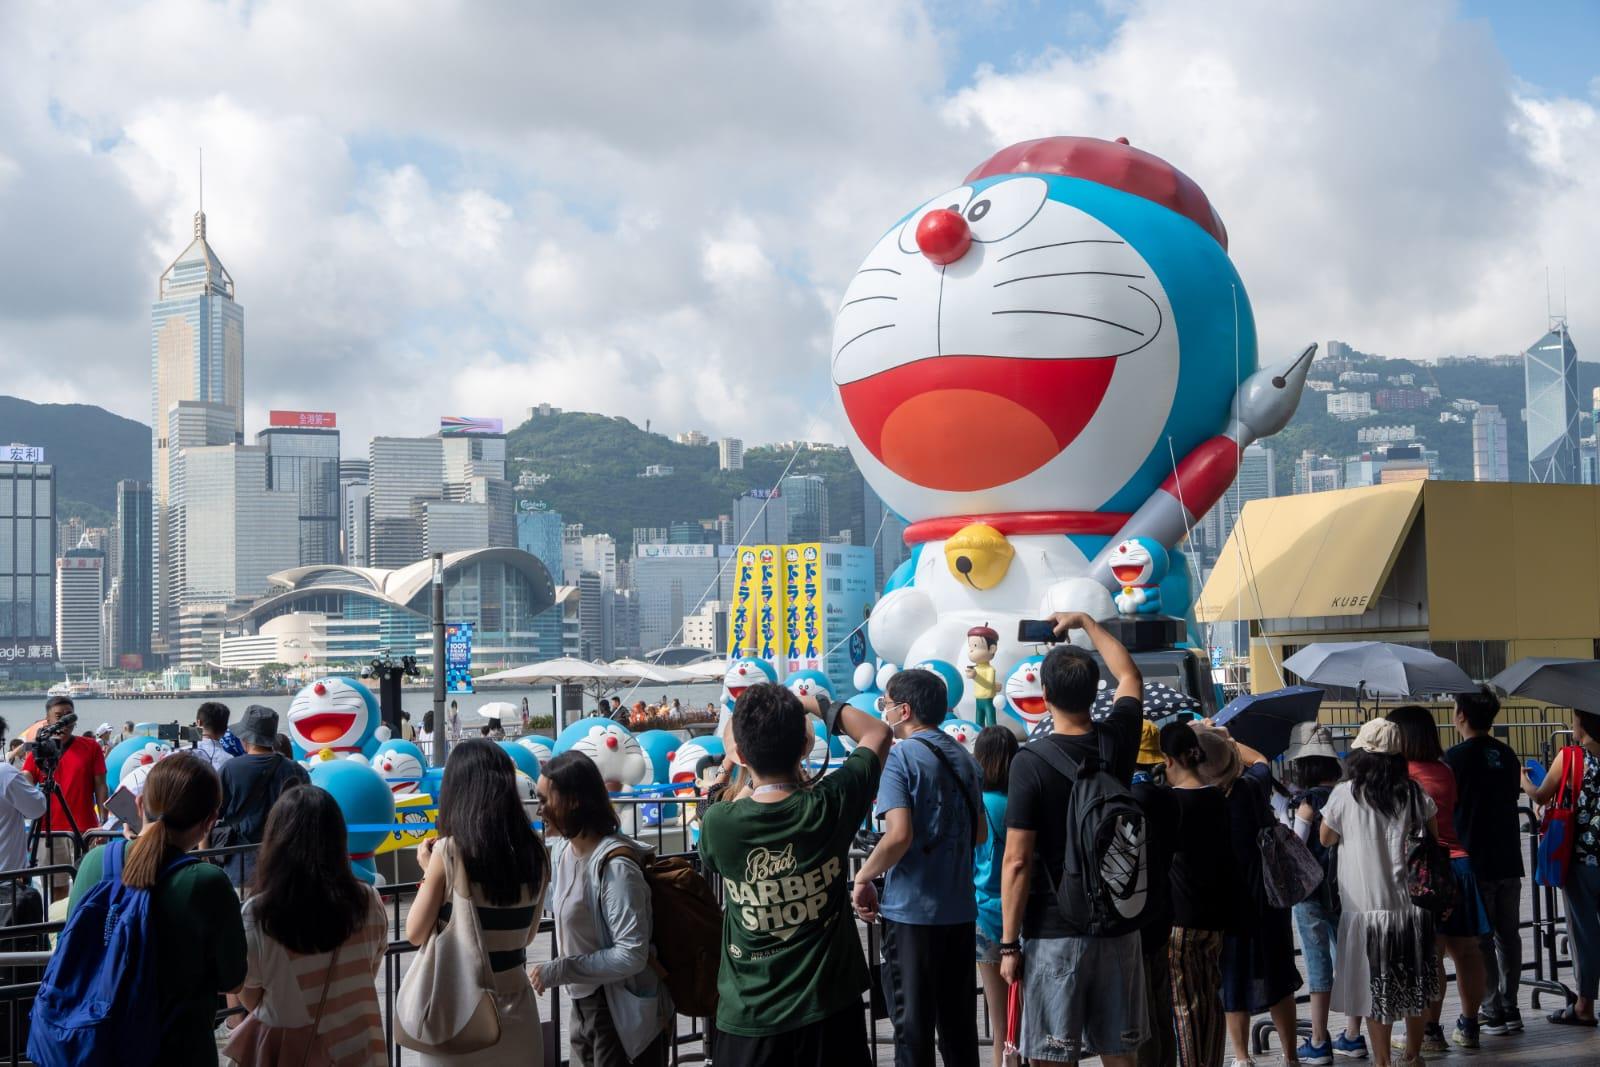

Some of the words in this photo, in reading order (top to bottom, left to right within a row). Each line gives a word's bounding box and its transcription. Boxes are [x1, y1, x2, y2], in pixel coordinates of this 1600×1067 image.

[10, 448, 39, 461] 宏利
[731, 565, 754, 659] ドラえもん
[761, 565, 775, 659] ドラえもん
[787, 564, 800, 659] ドラえもん
[804, 562, 818, 659] ドラえもん
[1331, 595, 1369, 607] KUBE
[0, 644, 26, 660] agle
[723, 856, 842, 906] BARBER
[745, 842, 797, 885] Bad
[741, 891, 828, 931] SHOP
